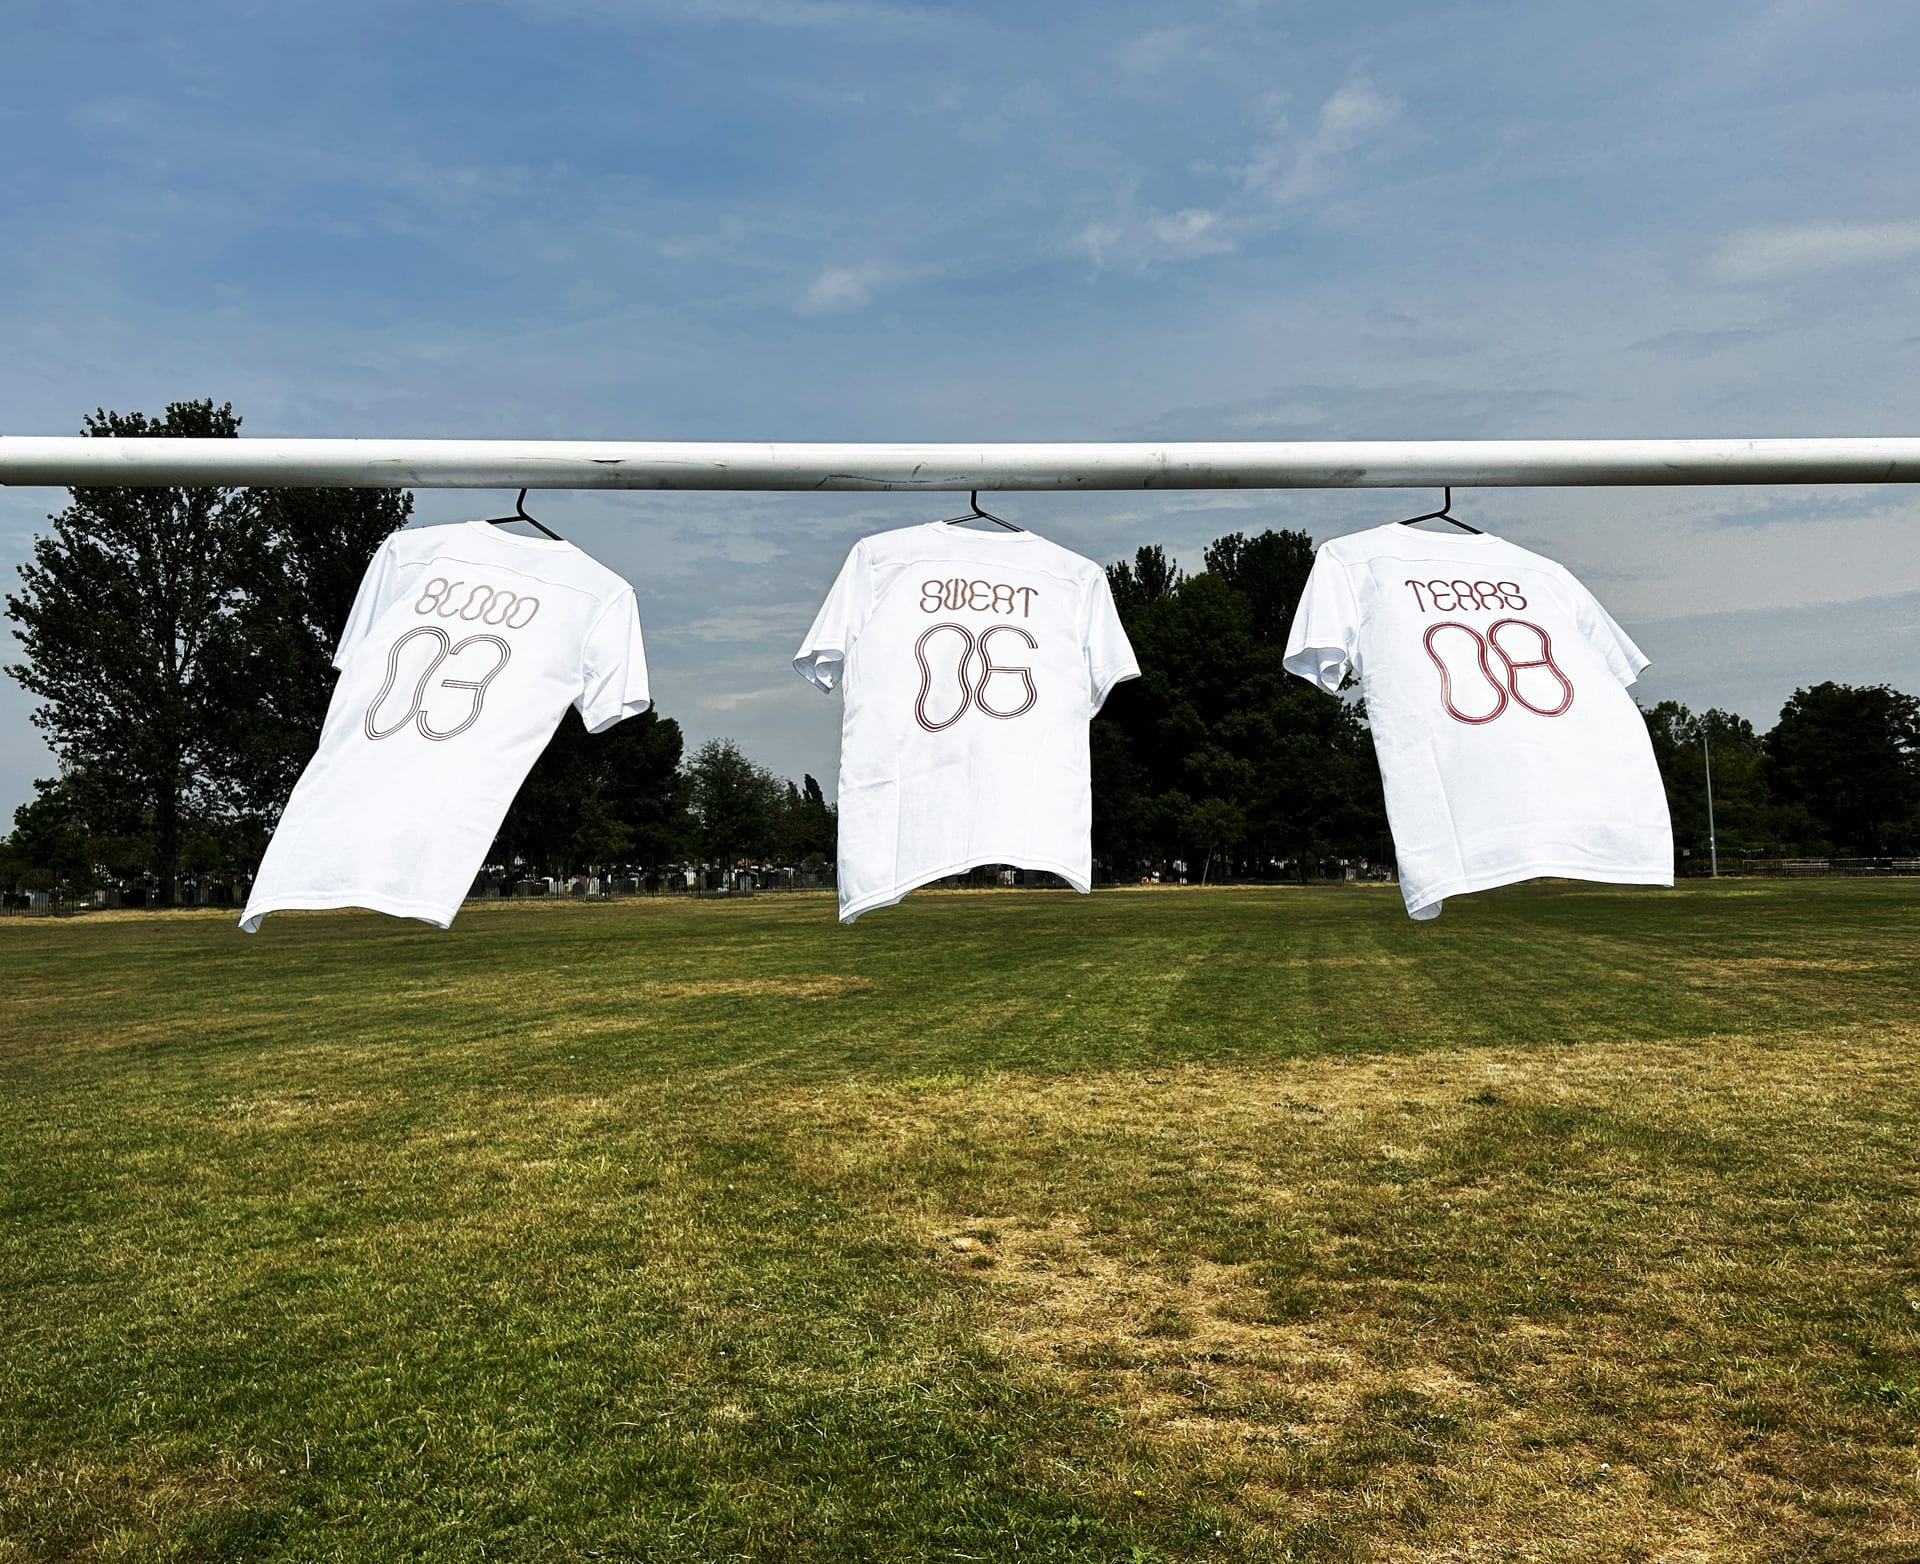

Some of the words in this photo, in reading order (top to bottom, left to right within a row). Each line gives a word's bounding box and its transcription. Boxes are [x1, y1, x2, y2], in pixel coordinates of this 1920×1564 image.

[920, 578, 1039, 618] SWEAT
[1405, 580, 1528, 612] TEARS
[365, 626, 511, 741] 03
[914, 622, 1039, 732] 06
[1423, 618, 1574, 725] 08
